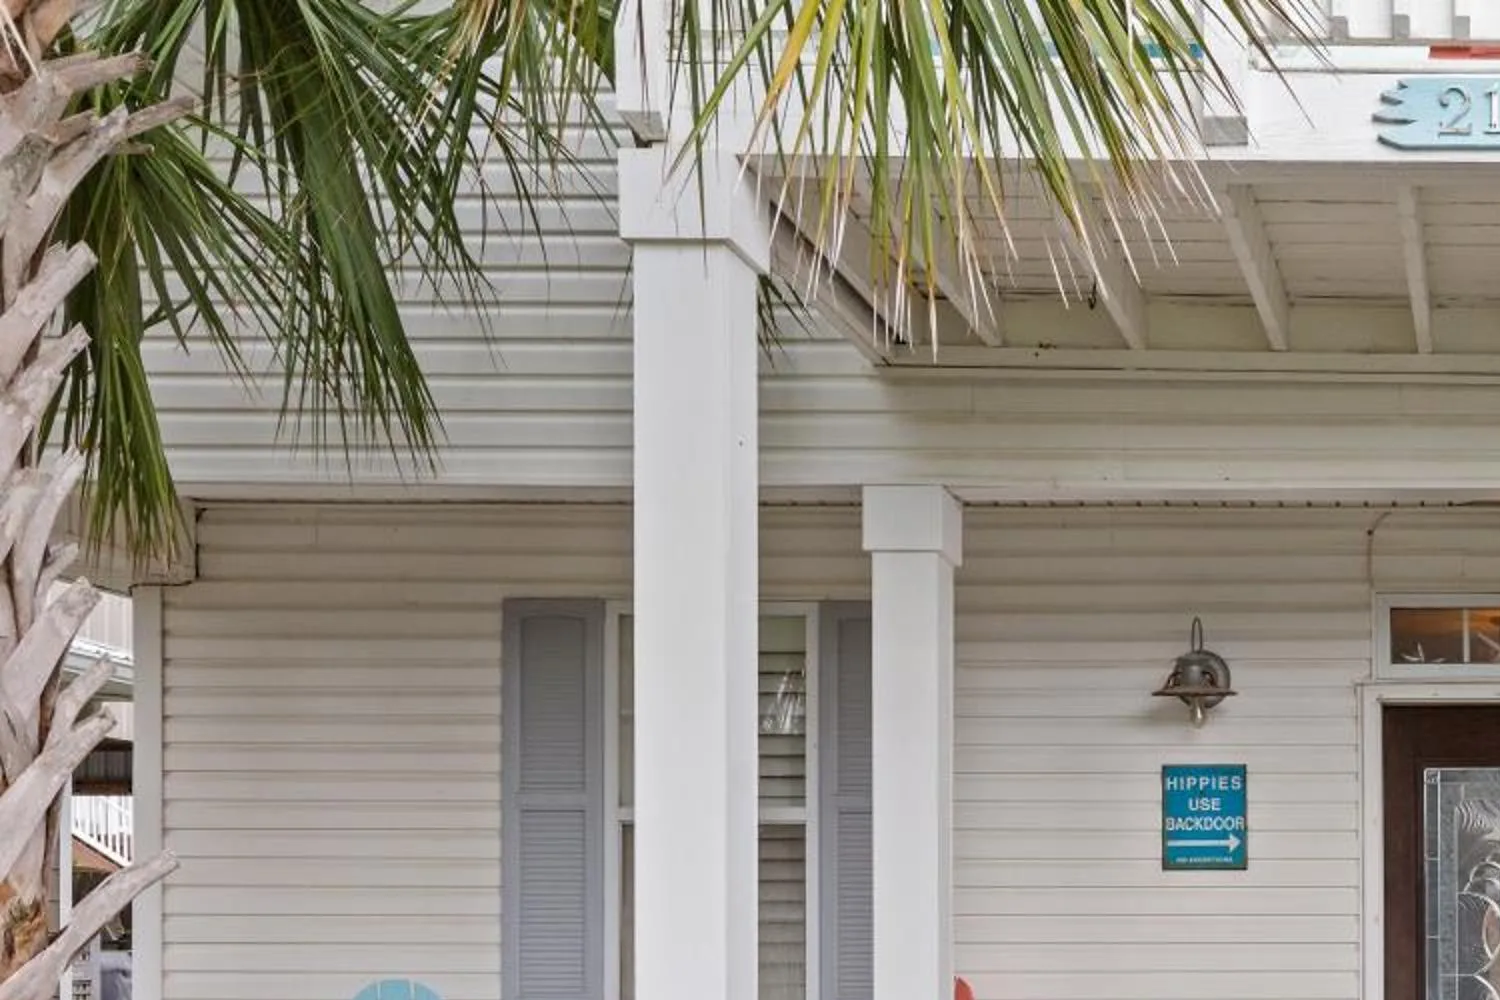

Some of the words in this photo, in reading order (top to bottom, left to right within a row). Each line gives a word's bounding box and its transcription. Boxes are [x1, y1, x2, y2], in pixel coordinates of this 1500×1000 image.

[1166, 776, 1242, 791] HIPPIES
[1188, 797, 1221, 811] USE
[1166, 816, 1245, 831] BACKDOOR
